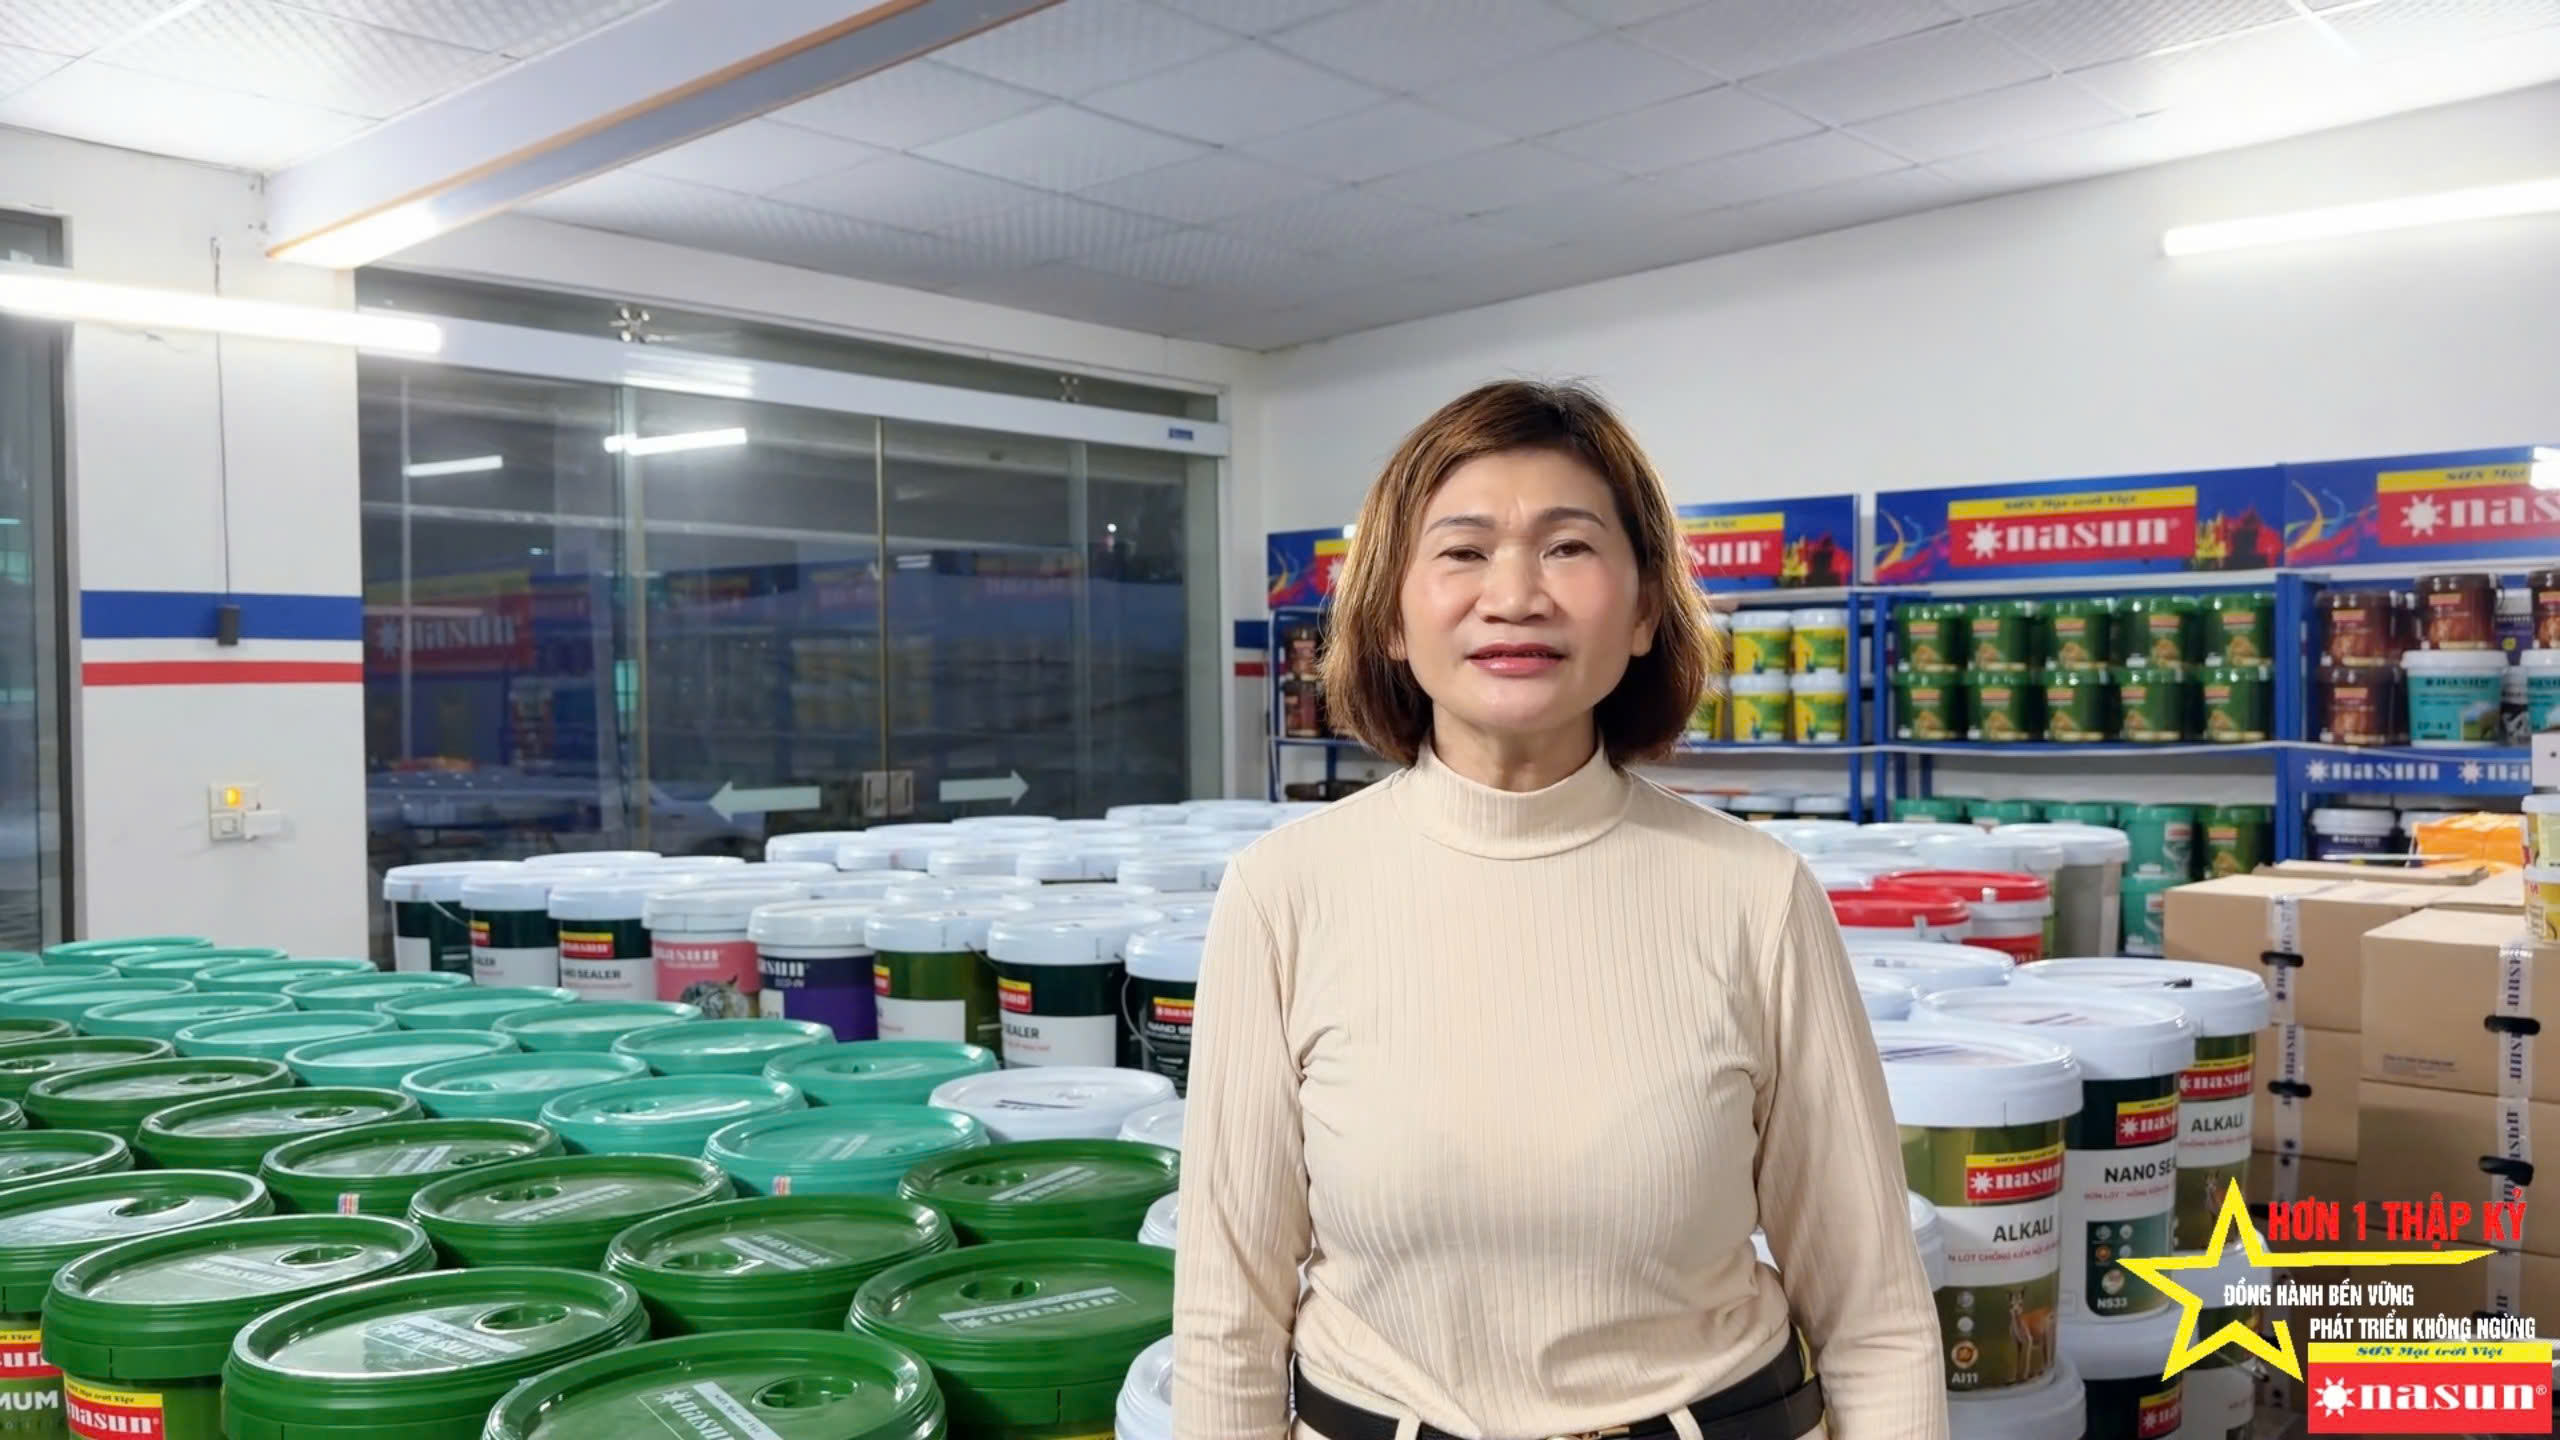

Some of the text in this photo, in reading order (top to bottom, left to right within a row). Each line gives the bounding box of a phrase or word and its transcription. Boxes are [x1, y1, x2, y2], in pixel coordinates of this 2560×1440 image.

[2332, 762, 2439, 781] nasun
[2191, 1112, 2244, 1133] ALKALI
[2104, 1162, 2156, 1184] NANO
[1992, 1215, 2054, 1243] ALKALI
